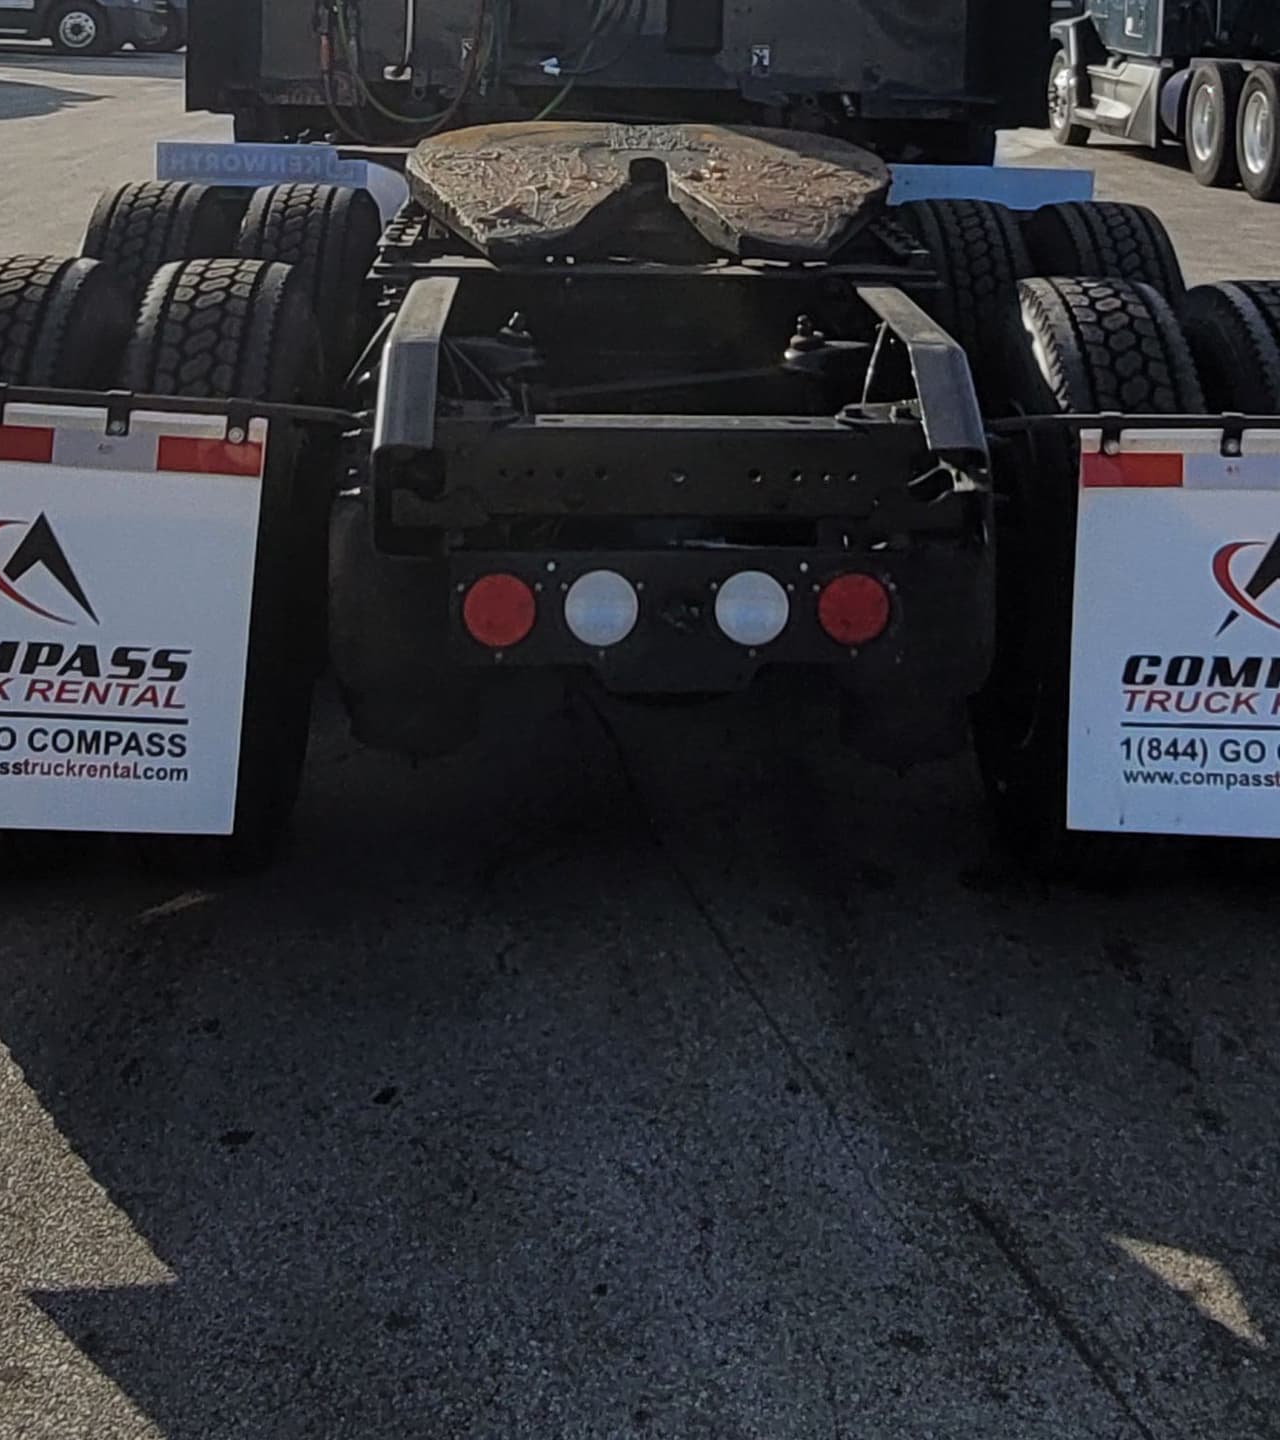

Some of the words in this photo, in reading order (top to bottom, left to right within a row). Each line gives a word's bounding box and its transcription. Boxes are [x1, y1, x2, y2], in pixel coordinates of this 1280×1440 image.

[24, 679, 187, 709] RENTAL
[1122, 690, 1260, 715] TRUCK
[27, 728, 187, 758] COMPASS
[1120, 737, 1209, 768] 1(844)
[1219, 738, 1266, 763] GO
